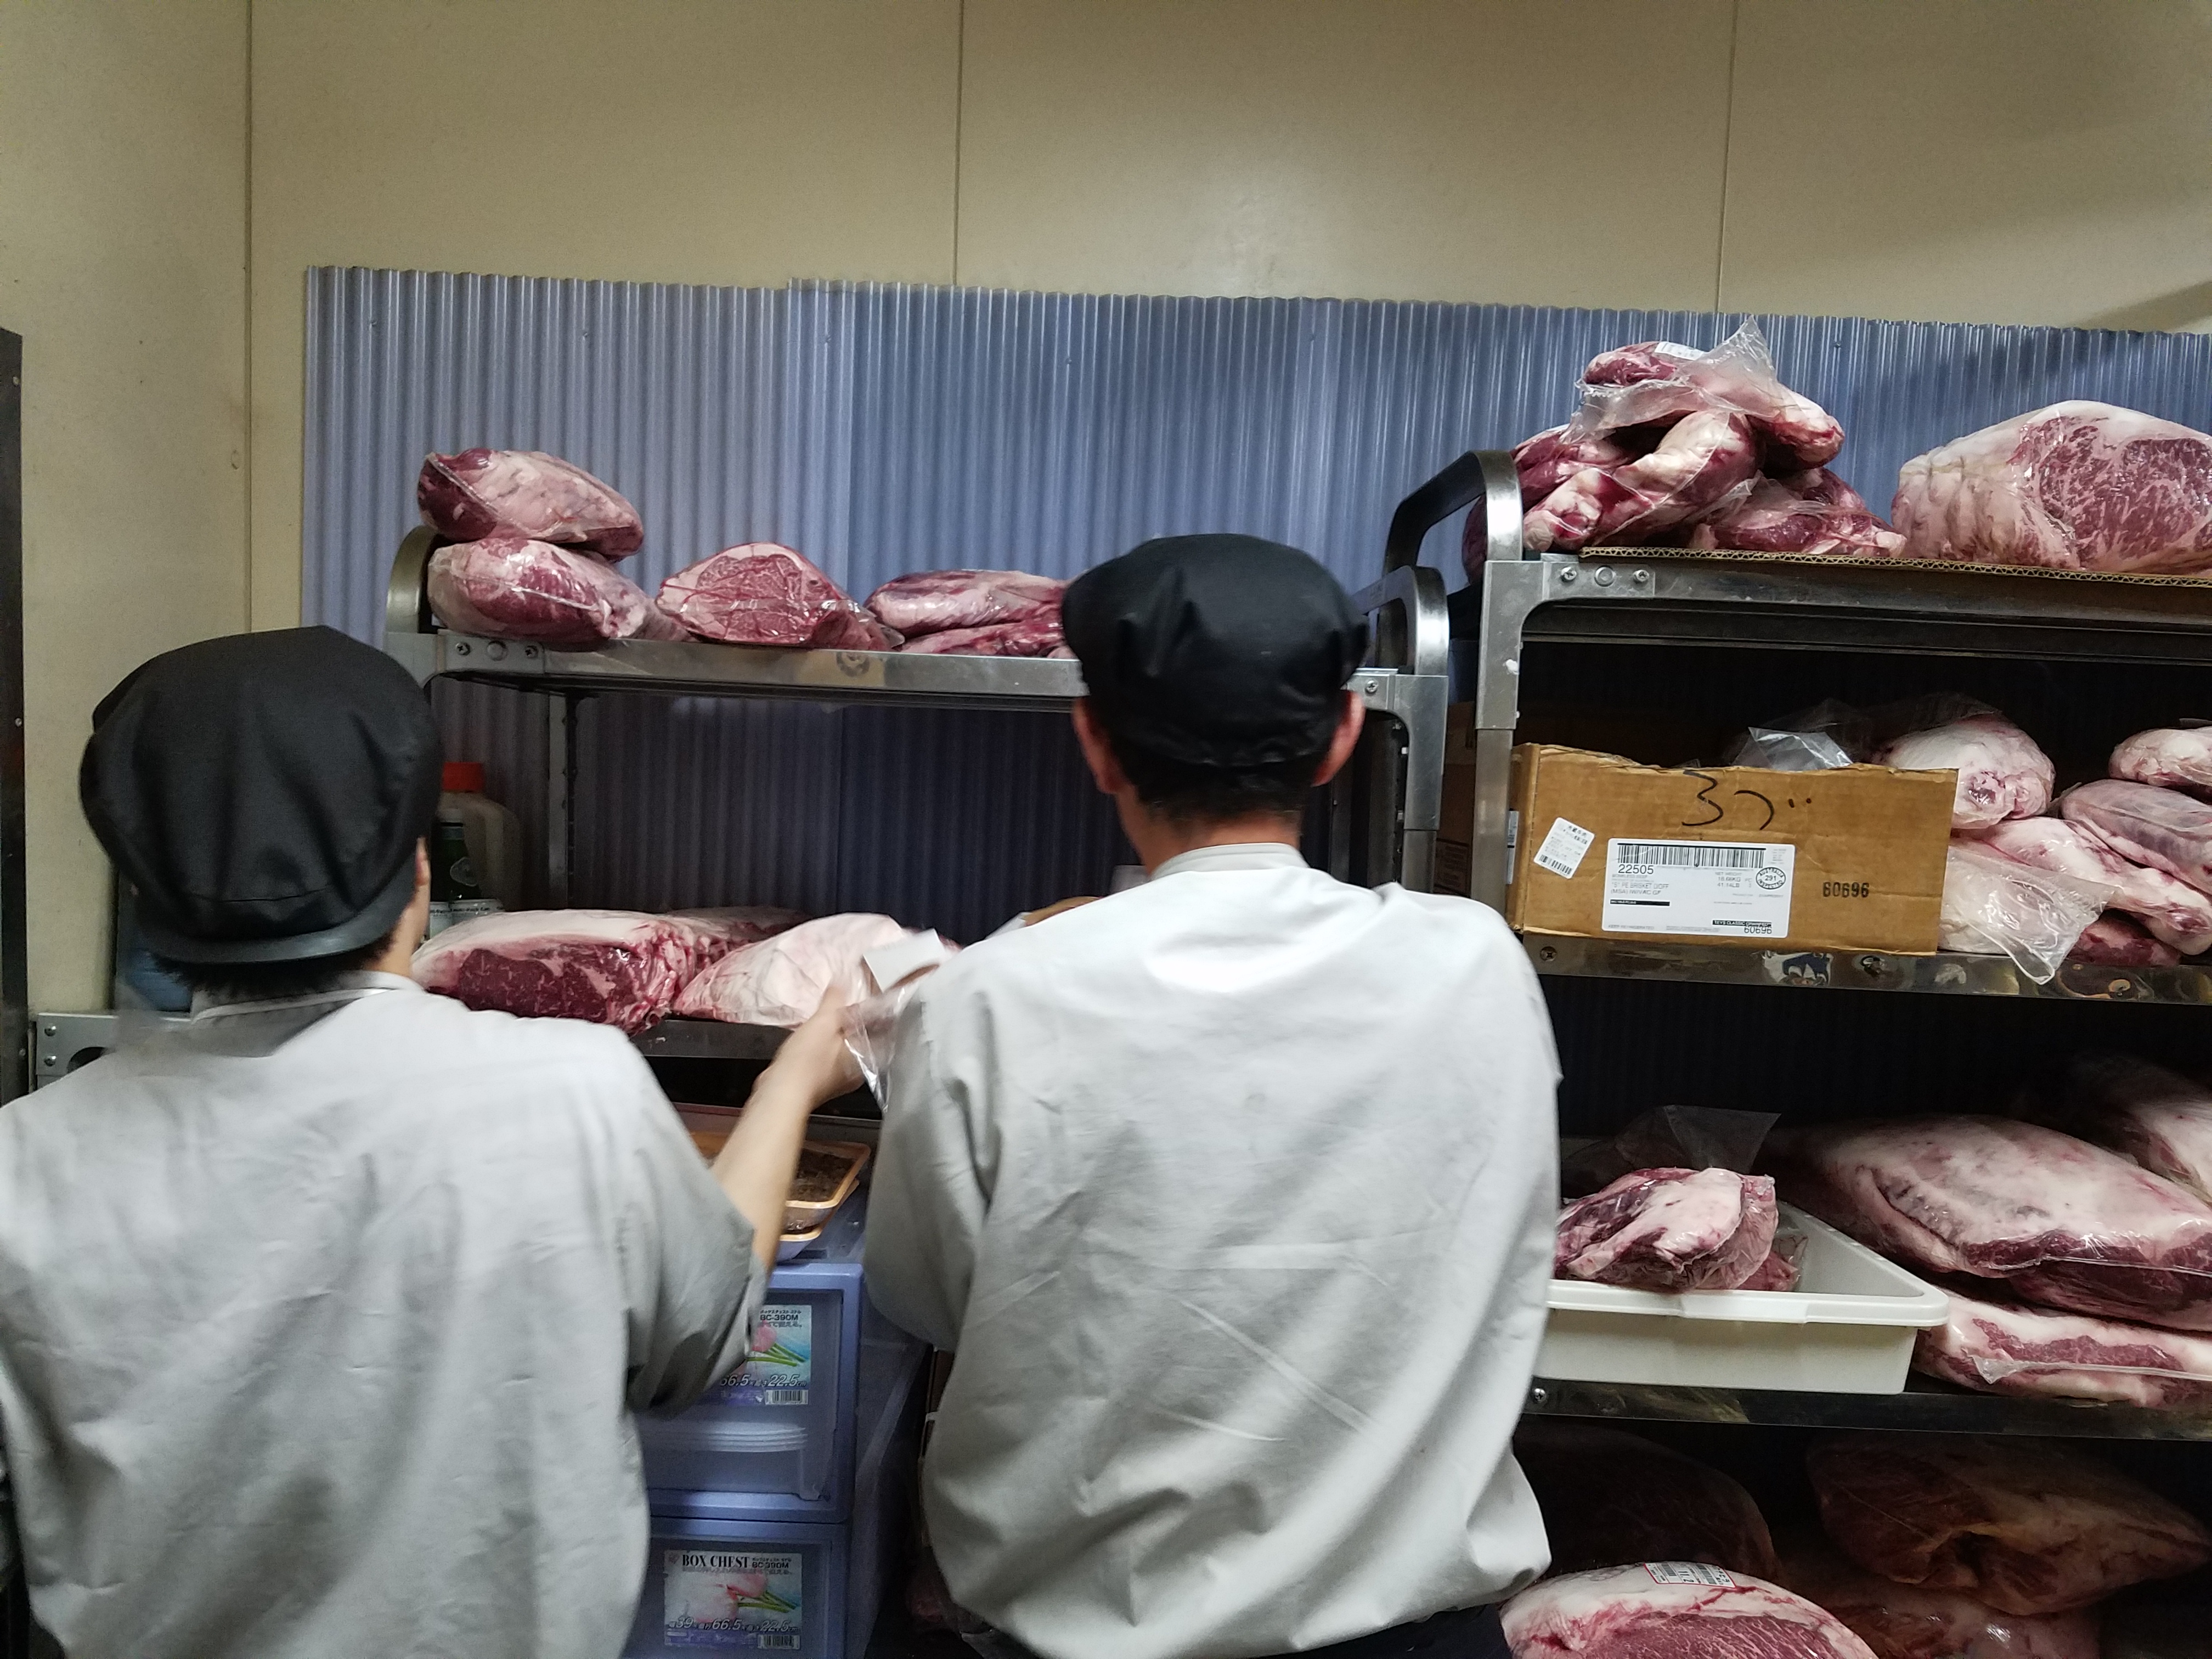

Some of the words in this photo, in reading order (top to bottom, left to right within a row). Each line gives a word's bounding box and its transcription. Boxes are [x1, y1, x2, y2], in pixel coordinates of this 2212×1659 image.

[1618, 864, 1654, 874] 22505
[1759, 868, 1784, 878] AUSTRALIA
[1822, 881, 1870, 898] 60696
[682, 1554, 707, 1567] BOX
[710, 1555, 749, 1568] CHEST
